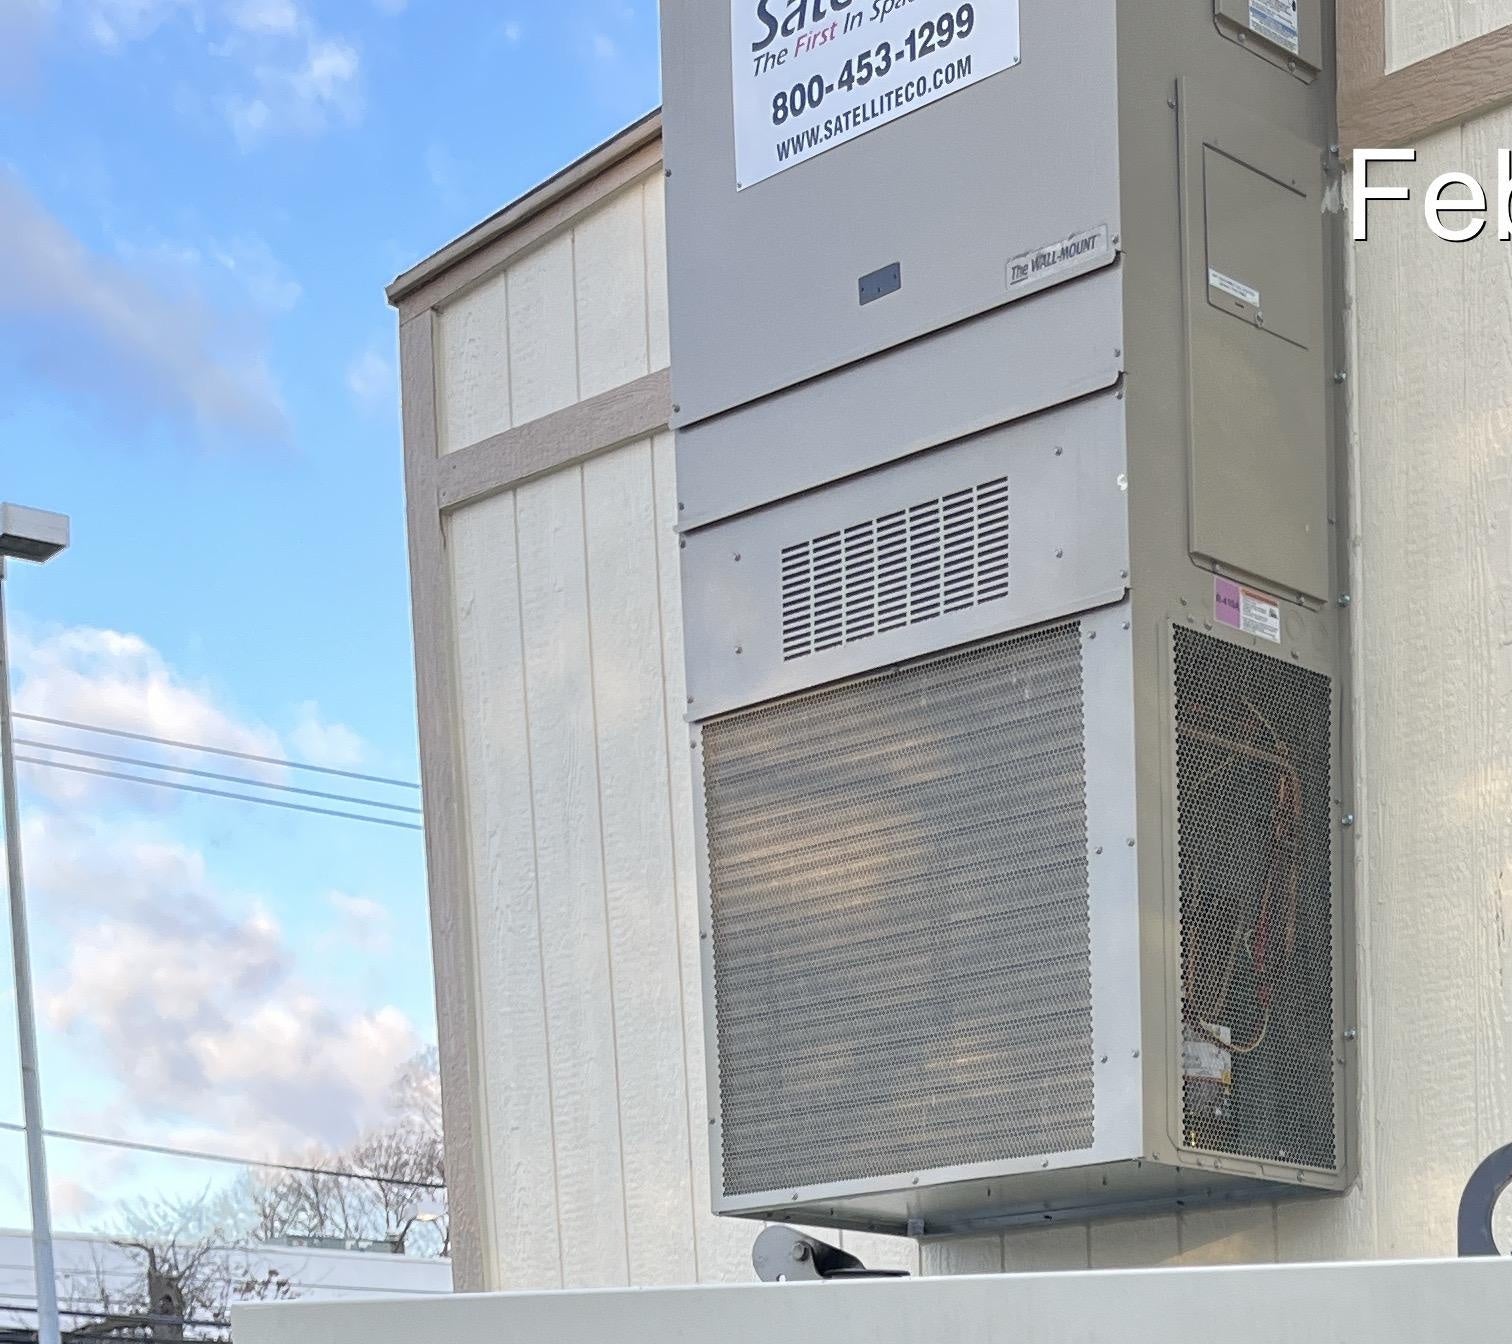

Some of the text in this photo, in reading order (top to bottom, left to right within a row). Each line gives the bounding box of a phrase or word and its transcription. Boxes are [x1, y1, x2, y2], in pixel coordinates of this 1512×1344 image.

[753, 49, 788, 77] The
[795, 21, 838, 58] First
[842, 11, 864, 35] In
[771, 2, 975, 126] 800-453-1299
[776, 55, 973, 162] WWW.SATELLITECO.COM
[1010, 235, 1097, 285] The WALL-MOUNT
